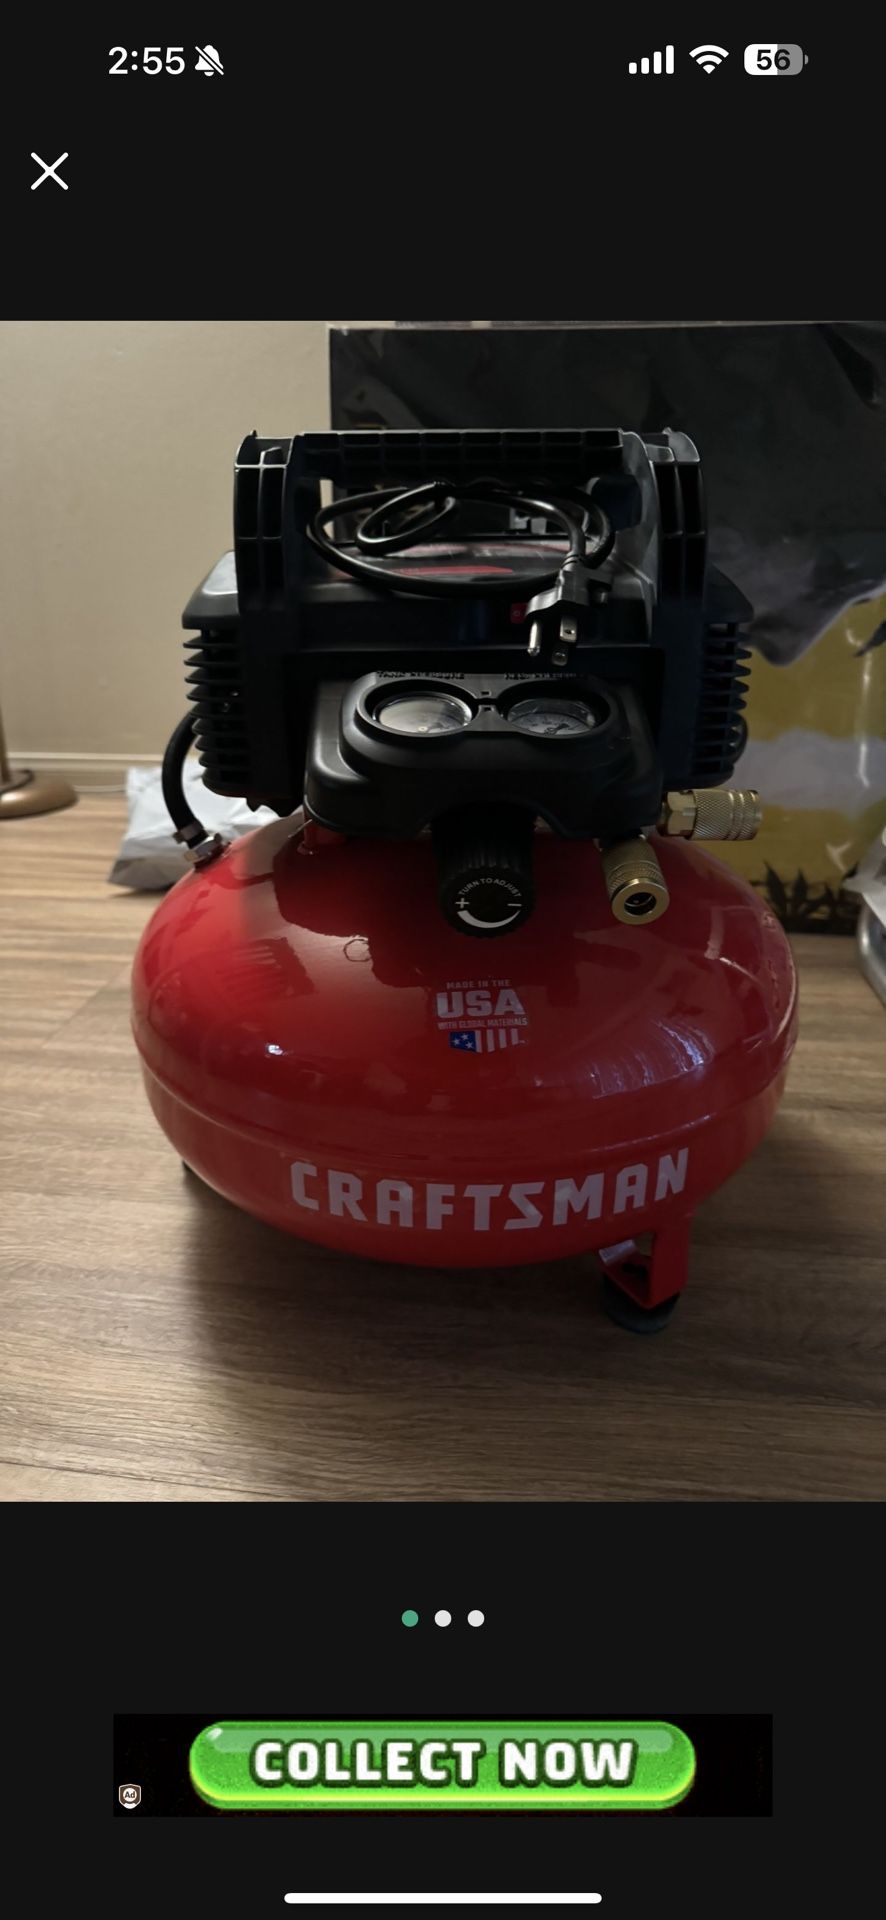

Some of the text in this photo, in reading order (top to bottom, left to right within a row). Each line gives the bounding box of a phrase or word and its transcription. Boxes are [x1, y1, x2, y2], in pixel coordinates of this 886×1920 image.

[108, 46, 186, 75] 2:55
[756, 48, 791, 71] 56
[458, 877, 522, 896] TURN TO ADJUST
[446, 979, 511, 989] MADE IN THE
[436, 988, 526, 1019] USA
[290, 1147, 690, 1232] CRAFTSMAN
[252, 1740, 638, 1784] COLLECT NOW
[124, 1790, 136, 1799] Ad
